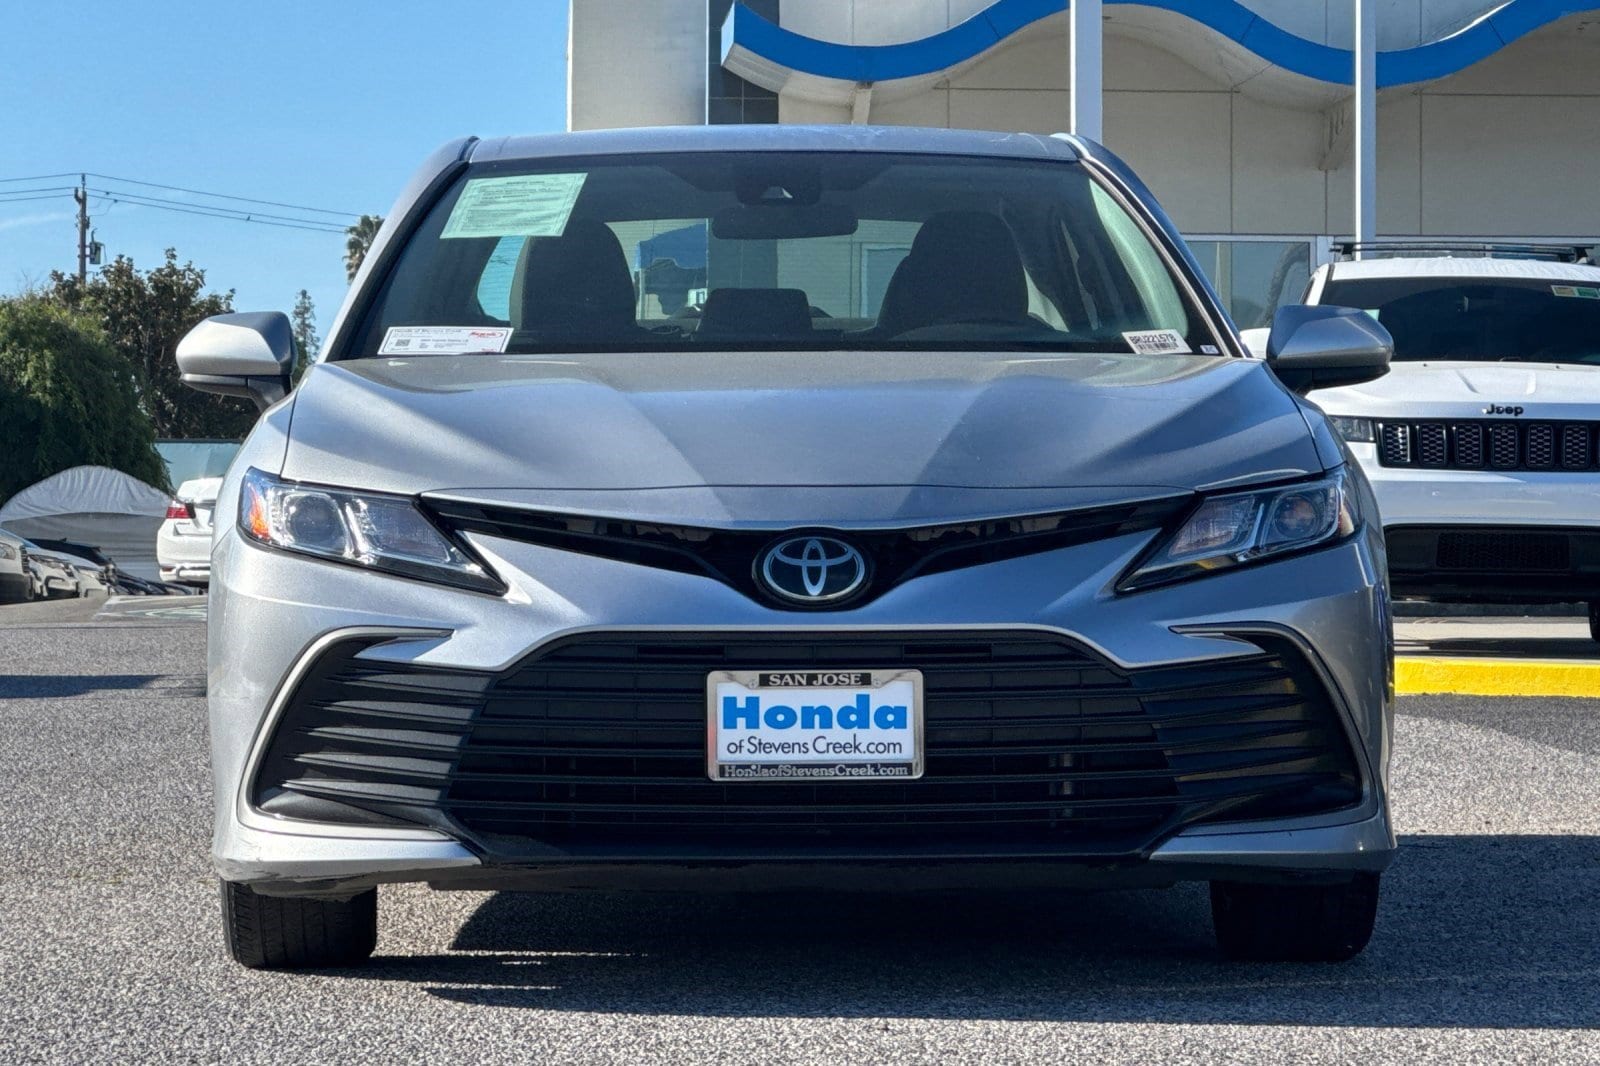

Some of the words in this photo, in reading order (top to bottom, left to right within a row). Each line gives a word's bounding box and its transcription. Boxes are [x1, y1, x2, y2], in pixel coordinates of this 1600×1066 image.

[1486, 403, 1524, 417] Jeep
[768, 673, 808, 686] SAN
[812, 673, 862, 686] JOSE
[722, 693, 907, 730] Honda
[726, 739, 744, 754] of
[747, 735, 809, 754] Stevens
[812, 733, 902, 754] Creek.com
[724, 764, 908, 777] HondaofStevensCreek.com
